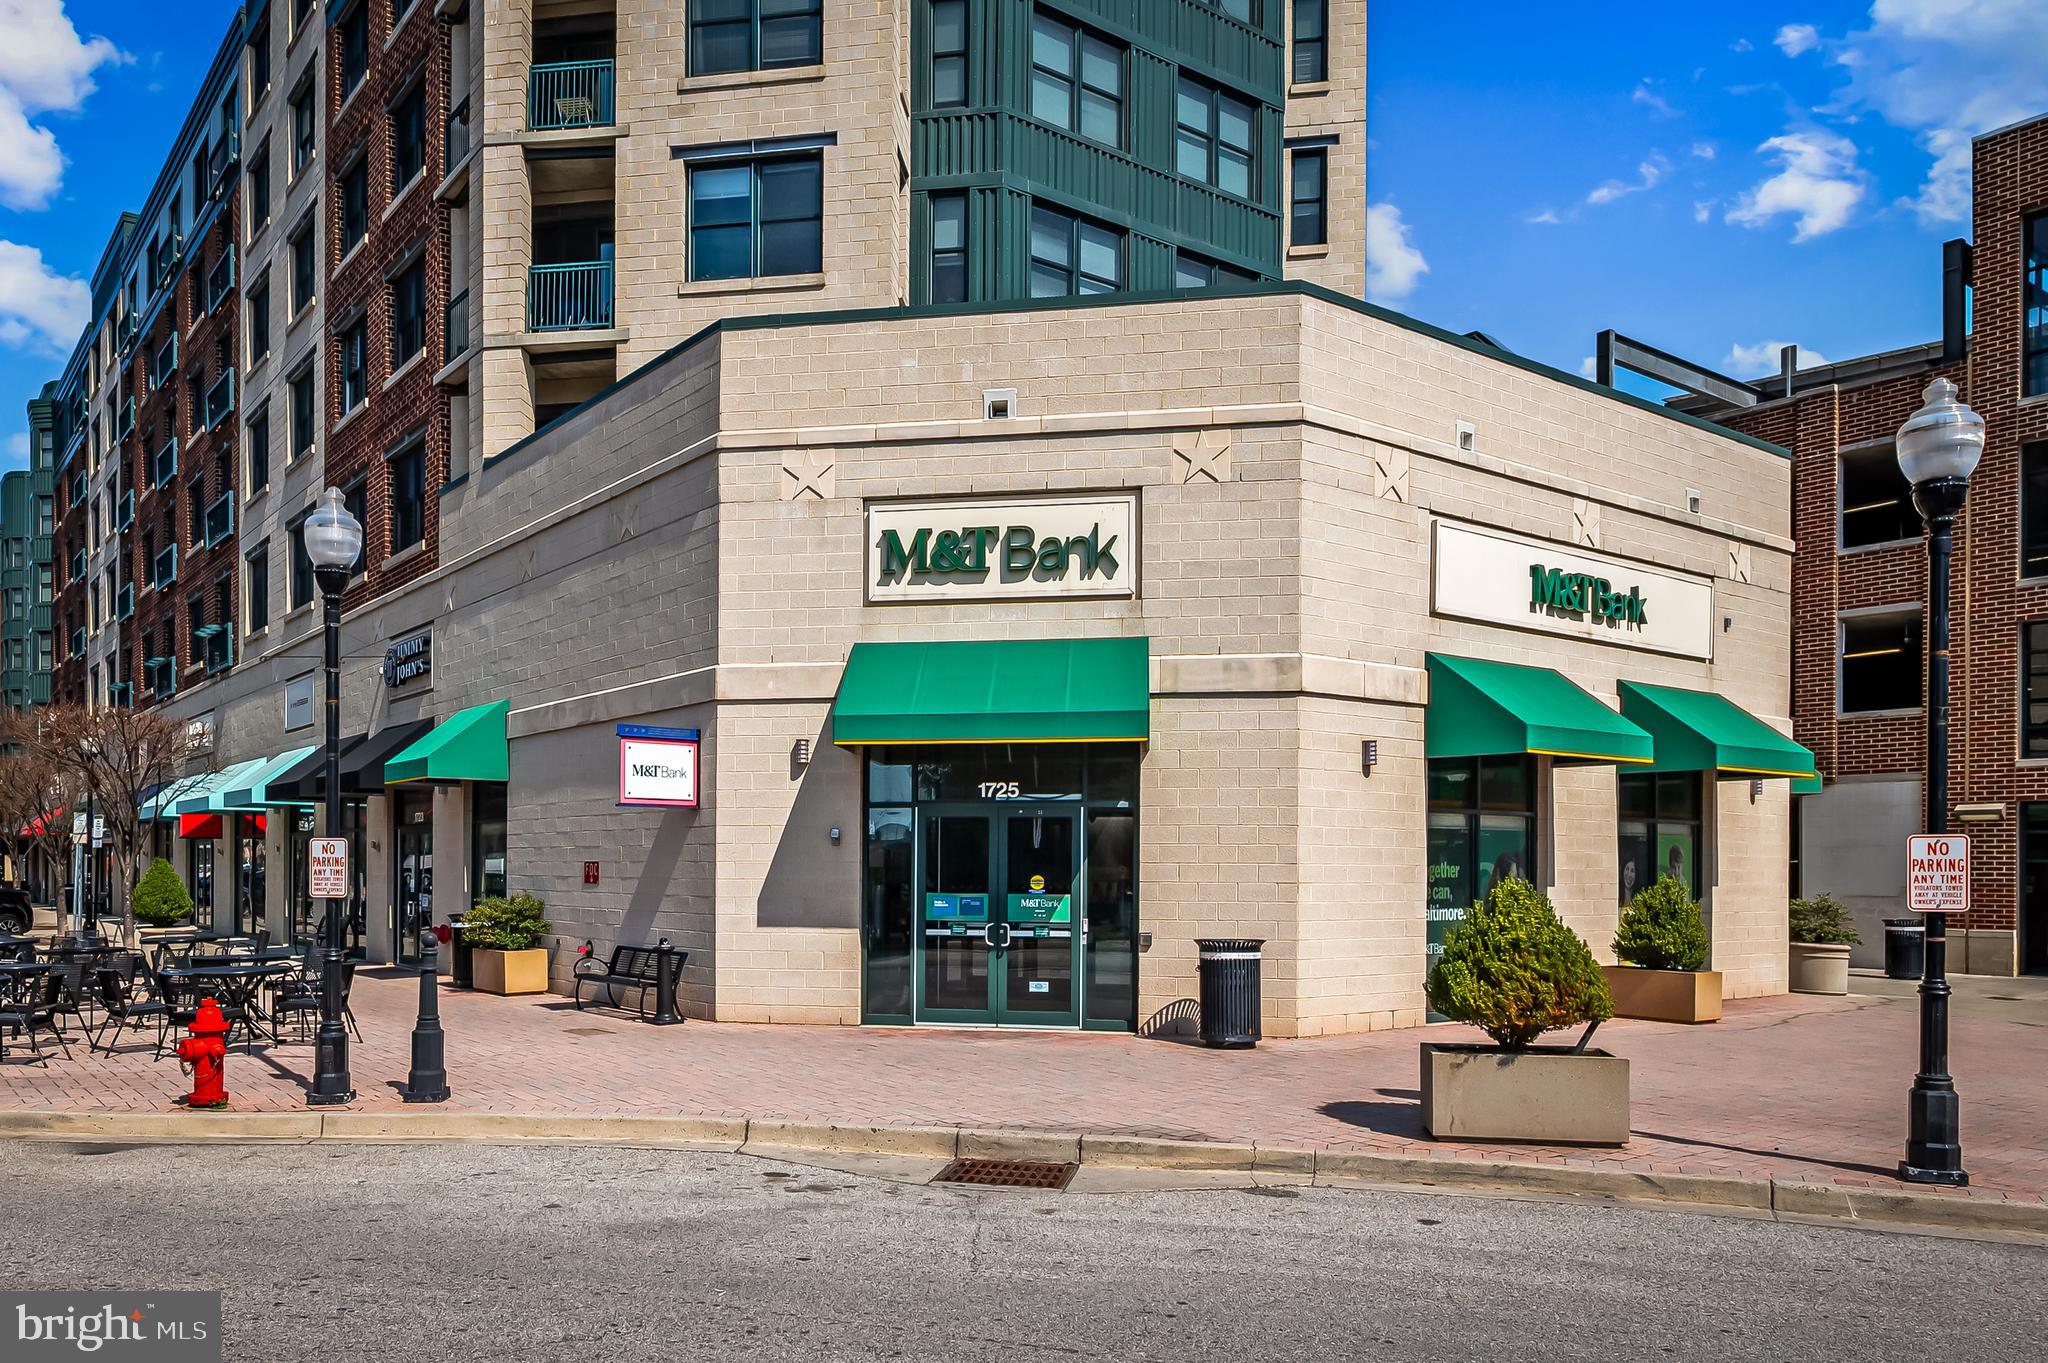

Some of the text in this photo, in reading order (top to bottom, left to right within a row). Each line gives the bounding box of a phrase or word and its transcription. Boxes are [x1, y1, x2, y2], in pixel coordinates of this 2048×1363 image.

[877, 523, 1119, 583] M&T Bank
[1529, 563, 1648, 631] M&T Bank
[397, 637, 424, 658] JIMMY
[396, 659, 424, 685] JOHN'S
[632, 764, 687, 779] M&T Bank
[978, 782, 1020, 798] 1725
[321, 844, 336, 855] NO
[1927, 842, 1949, 855] NO
[312, 856, 345, 867] PARKING
[1912, 858, 1964, 872] PARKING
[313, 869, 344, 877] ANY TIME
[585, 863, 598, 876] FDC
[1913, 874, 1964, 884] ANY TIME
[1020, 898, 1059, 908] M&T Bank
